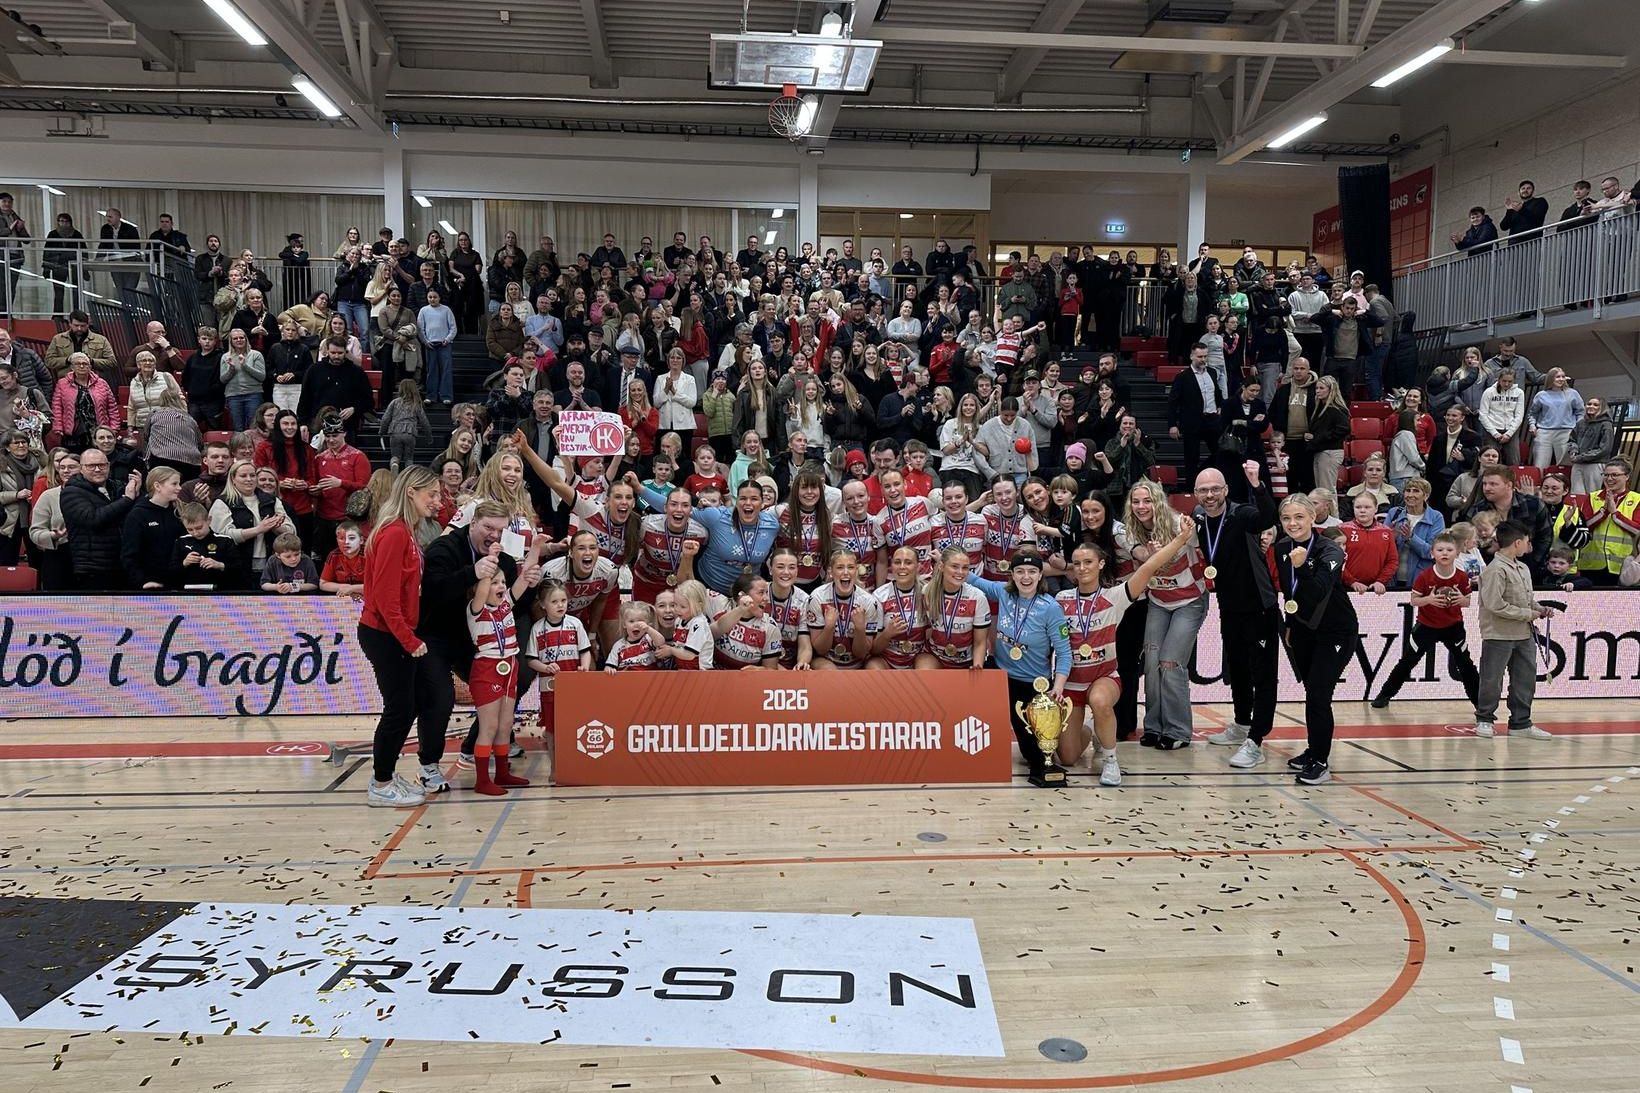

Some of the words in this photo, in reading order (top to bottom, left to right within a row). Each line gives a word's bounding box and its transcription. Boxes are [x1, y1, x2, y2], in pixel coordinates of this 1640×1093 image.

[560, 435, 575, 443] ERU
[596, 427, 616, 449] HK
[856, 526, 867, 536] 14
[905, 522, 925, 534] Arion
[1350, 534, 1359, 542] 22
[574, 584, 590, 597] 22
[728, 645, 754, 659] Arion
[110, 625, 132, 688] í
[154, 614, 345, 716] bragði
[762, 689, 809, 711] 2026
[589, 734, 602, 742] 66
[627, 721, 942, 753] GRILLDEILDARMEISTARAR
[112, 953, 976, 1009] SYRUSSON
